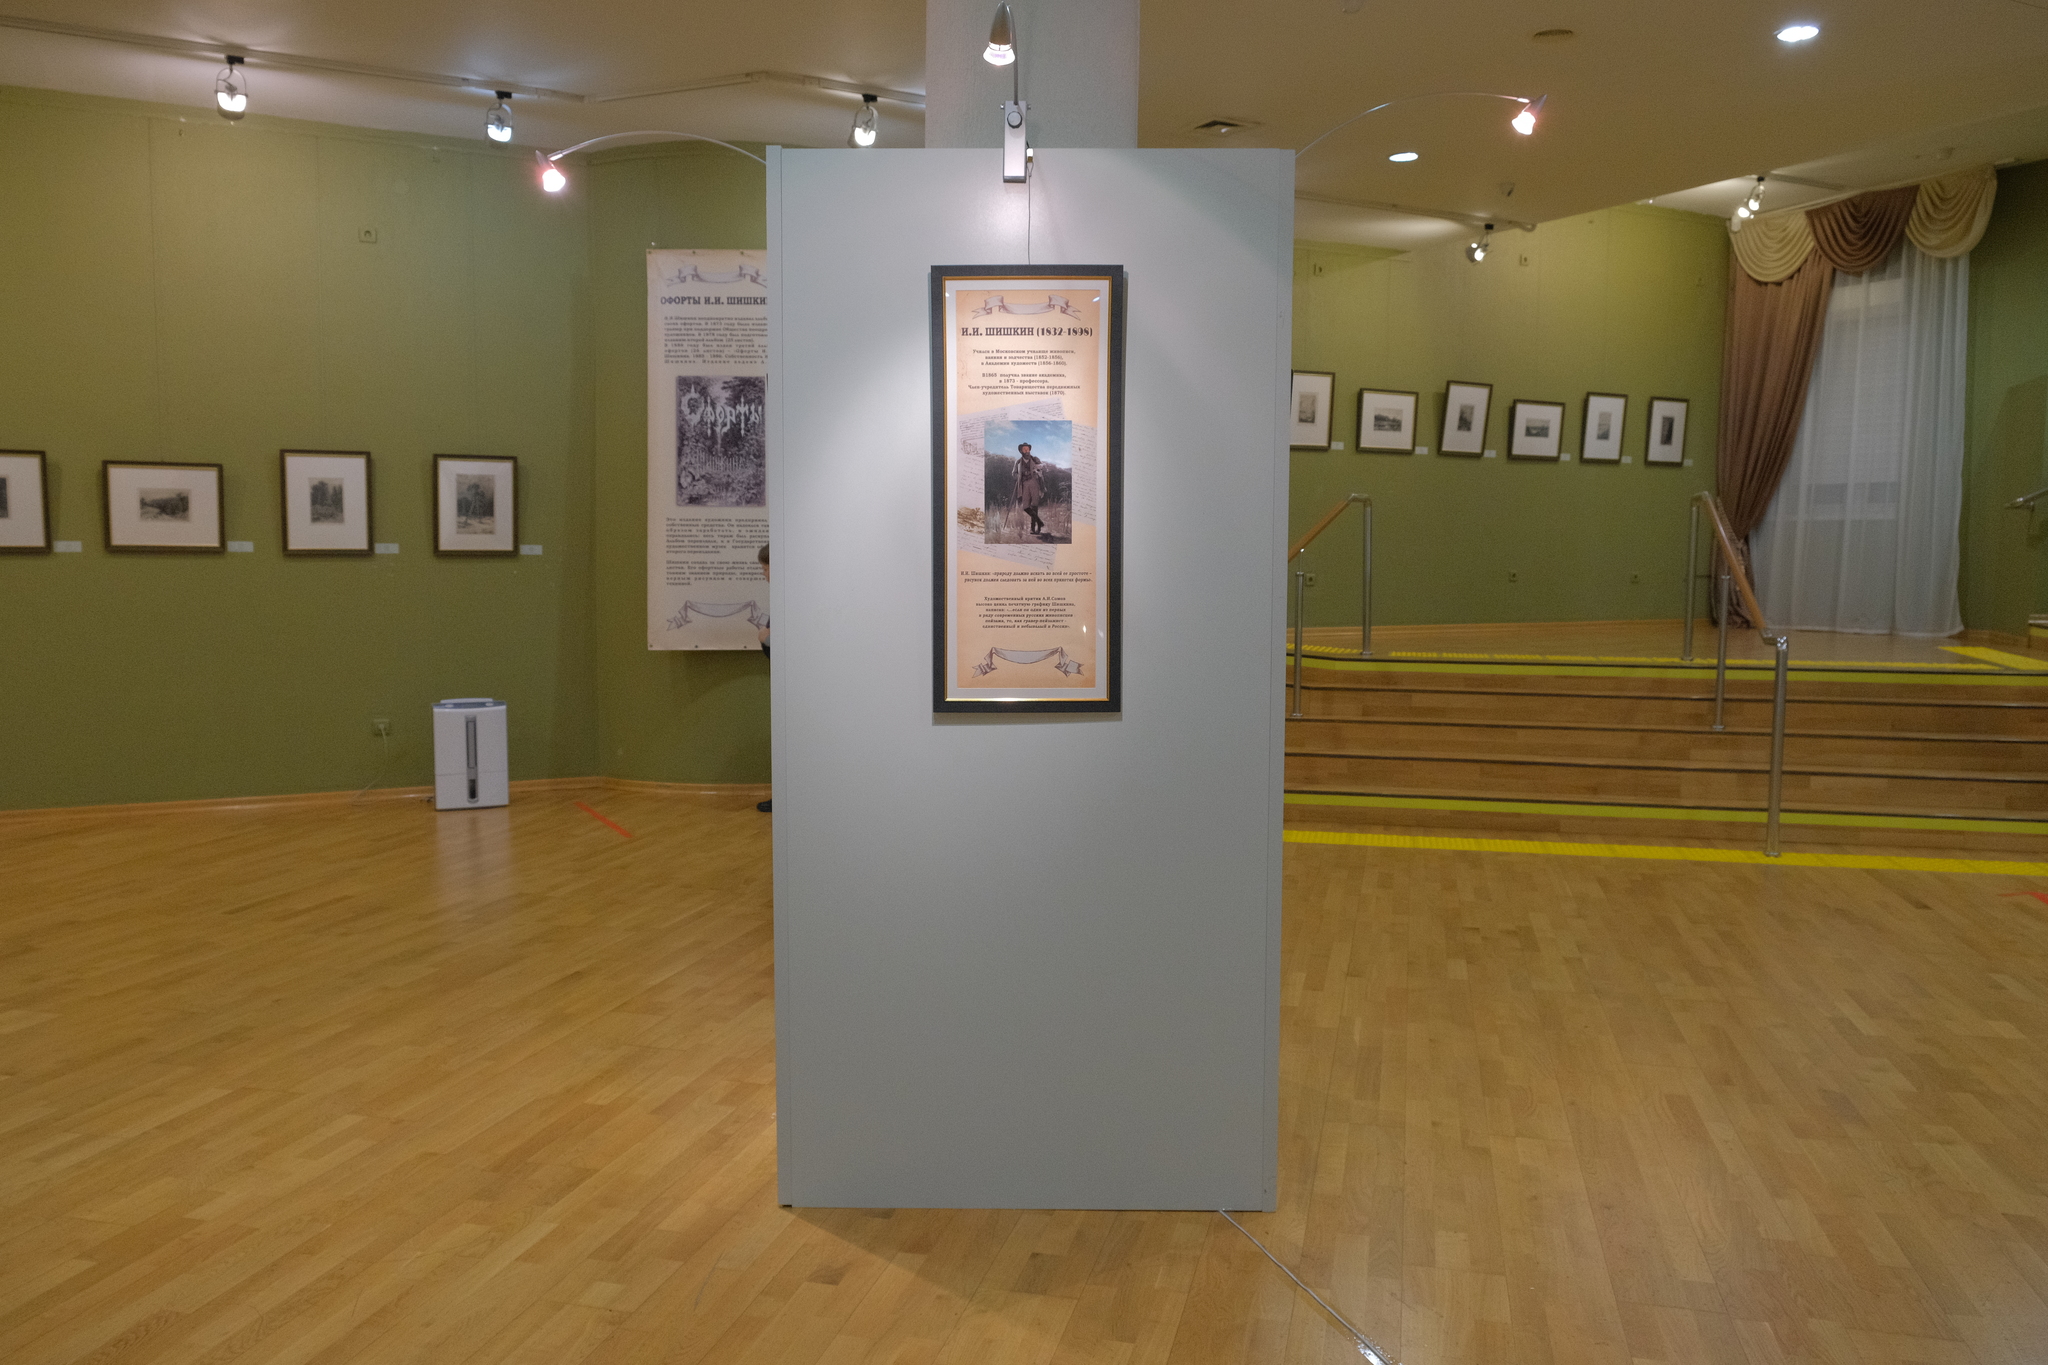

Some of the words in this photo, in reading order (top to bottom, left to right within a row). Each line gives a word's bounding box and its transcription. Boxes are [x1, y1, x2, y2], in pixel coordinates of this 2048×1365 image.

[661, 297, 701, 305] ОФОРТЫ
[704, 297, 724, 305] И.И.
[727, 297, 767, 305] ШИШКИ
[962, 327, 983, 336] И.И.
[985, 327, 1034, 336] ШИШКИН
[1037, 327, 1093, 336] (1832-1898)
